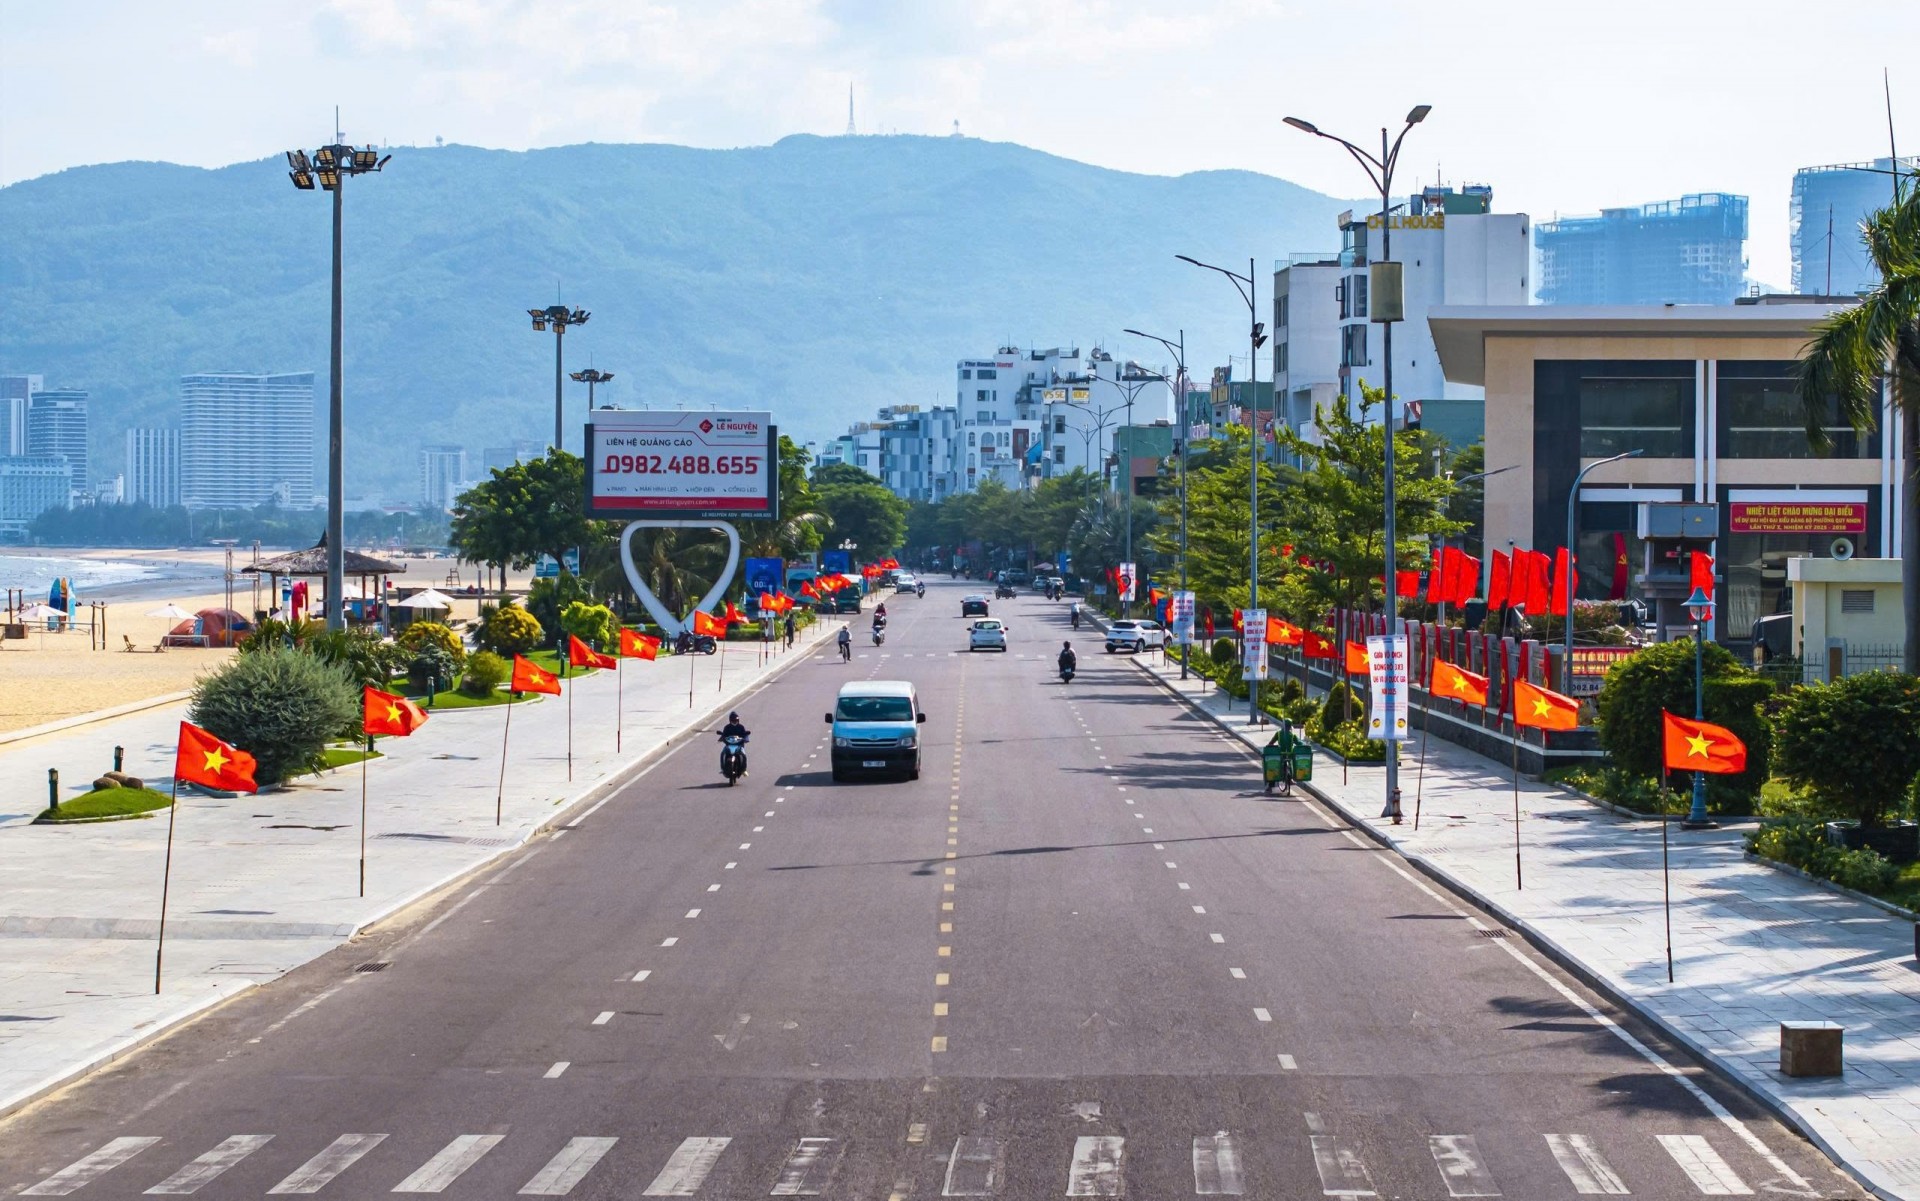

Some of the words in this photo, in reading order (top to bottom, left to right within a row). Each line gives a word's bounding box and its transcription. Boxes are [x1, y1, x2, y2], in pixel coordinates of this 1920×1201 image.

[1367, 215, 1401, 229] CHL
[1402, 215, 1444, 229] HOUSE
[716, 422, 726, 431] LÊ
[606, 438, 625, 446] LIÊN
[626, 438, 637, 447] HỆ
[641, 438, 671, 447] QUẢNG
[674, 437, 693, 447] CÁO
[602, 454, 760, 475] 0982.488.655
[1746, 505, 1765, 516] NHIỆT
[1767, 505, 1781, 516] LIỆT
[1782, 505, 1801, 515] CHÀO
[1802, 505, 1823, 516] MỪNG
